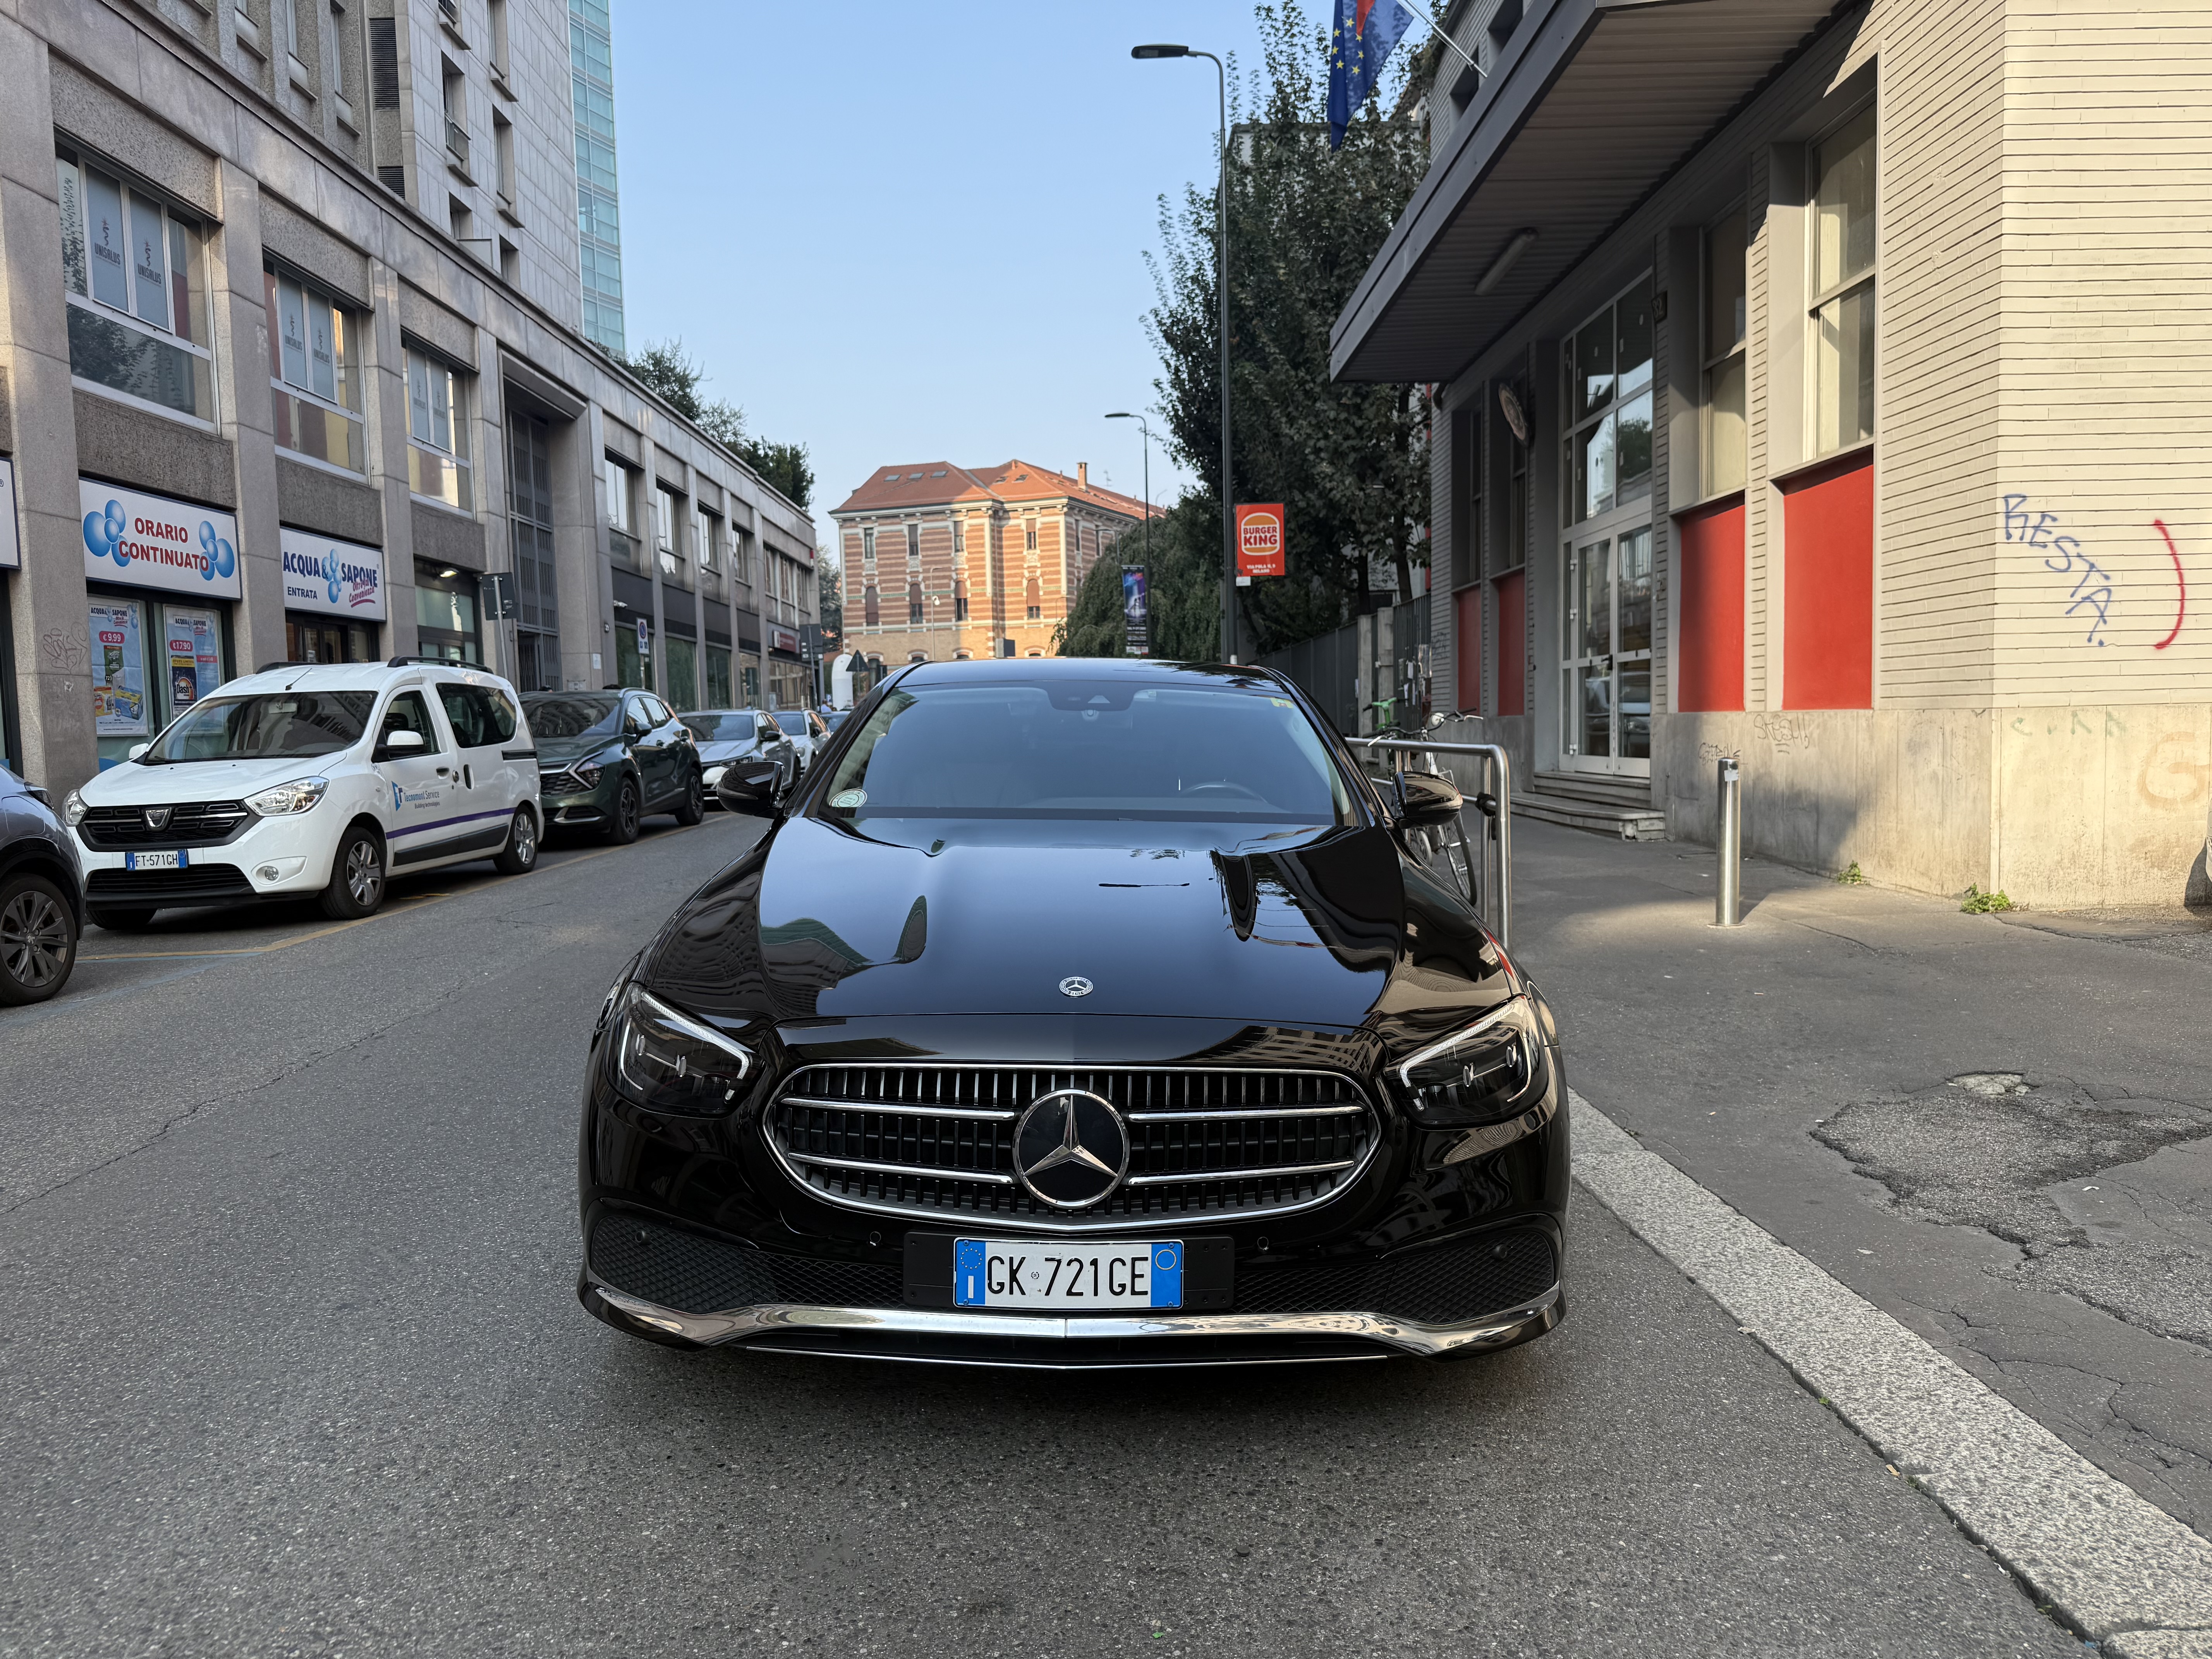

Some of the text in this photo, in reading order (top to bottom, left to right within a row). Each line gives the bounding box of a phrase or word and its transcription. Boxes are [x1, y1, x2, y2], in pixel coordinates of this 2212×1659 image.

[94, 242, 120, 265] UNISALUS
[138, 263, 161, 284] UNISALUS
[135, 517, 188, 543] ORARIO
[1243, 526, 1277, 535] BURGER
[1243, 534, 1277, 546] KING
[119, 540, 209, 572] CONTINUATO
[283, 551, 378, 588] ACQUA & SAPONE
[287, 586, 318, 599] ENTRATA
[112, 608, 127, 617] SAPONE
[108, 633, 121, 642] 9,99
[425, 790, 440, 800] Service
